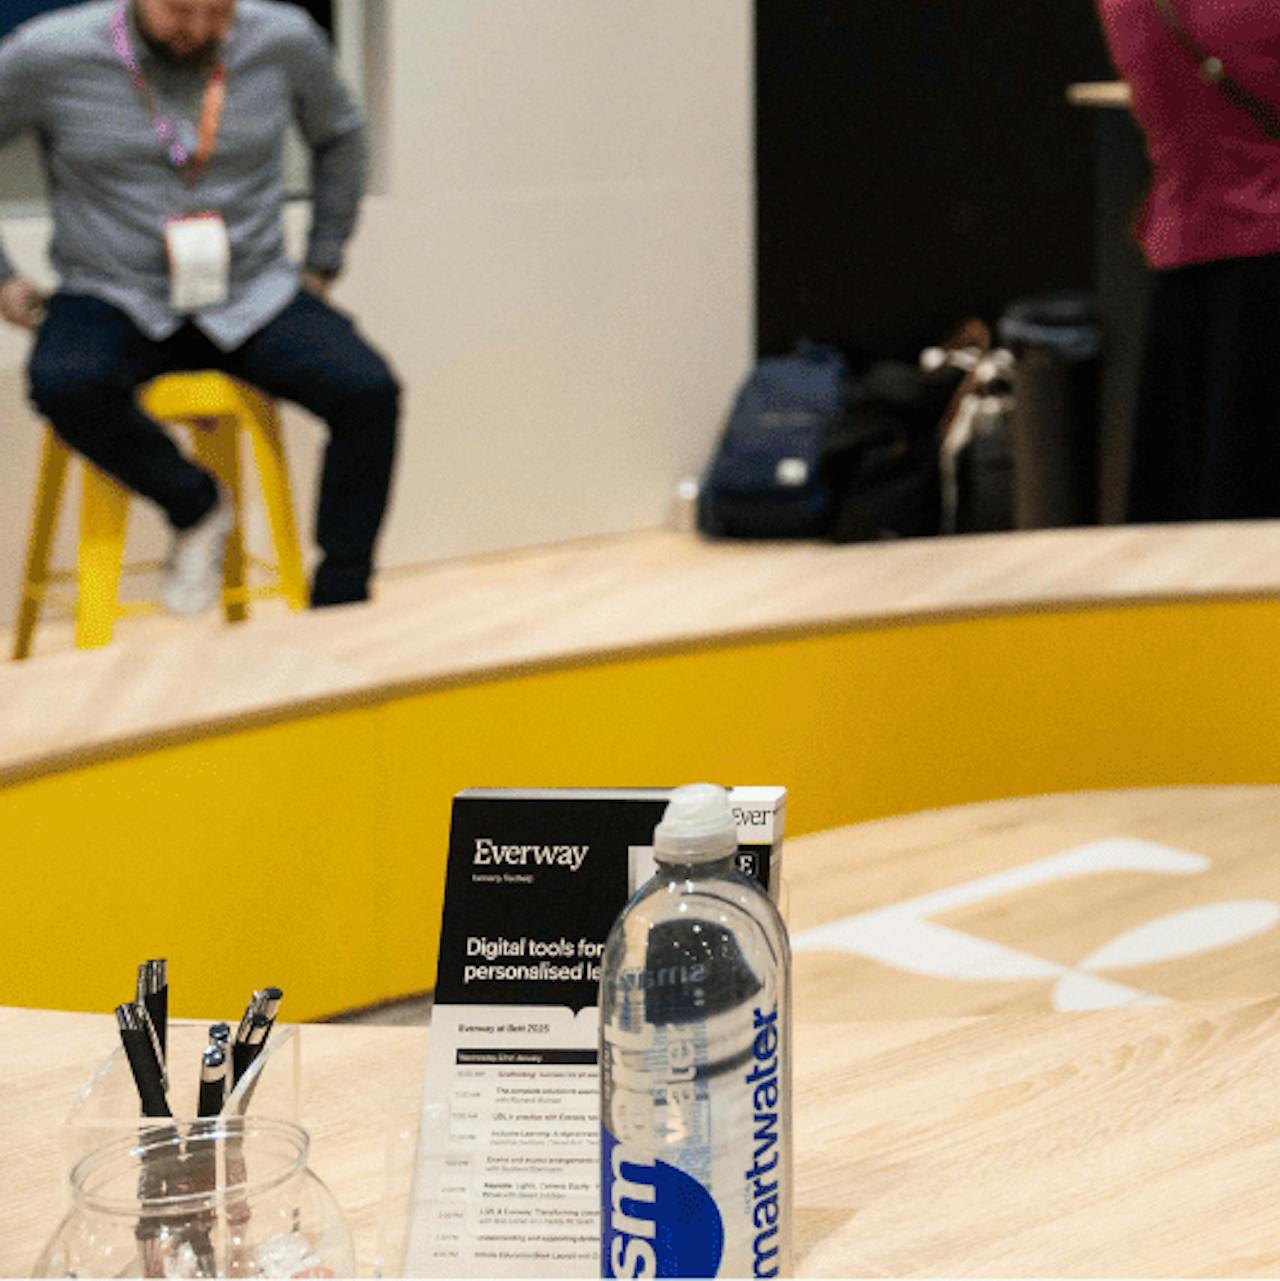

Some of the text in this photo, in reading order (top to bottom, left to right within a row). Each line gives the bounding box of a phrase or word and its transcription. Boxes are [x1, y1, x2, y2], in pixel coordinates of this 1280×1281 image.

[731, 807, 777, 827] Ever
[472, 837, 590, 872] Everway
[466, 936, 605, 961] Digital tools for
[463, 960, 585, 985] personalised
